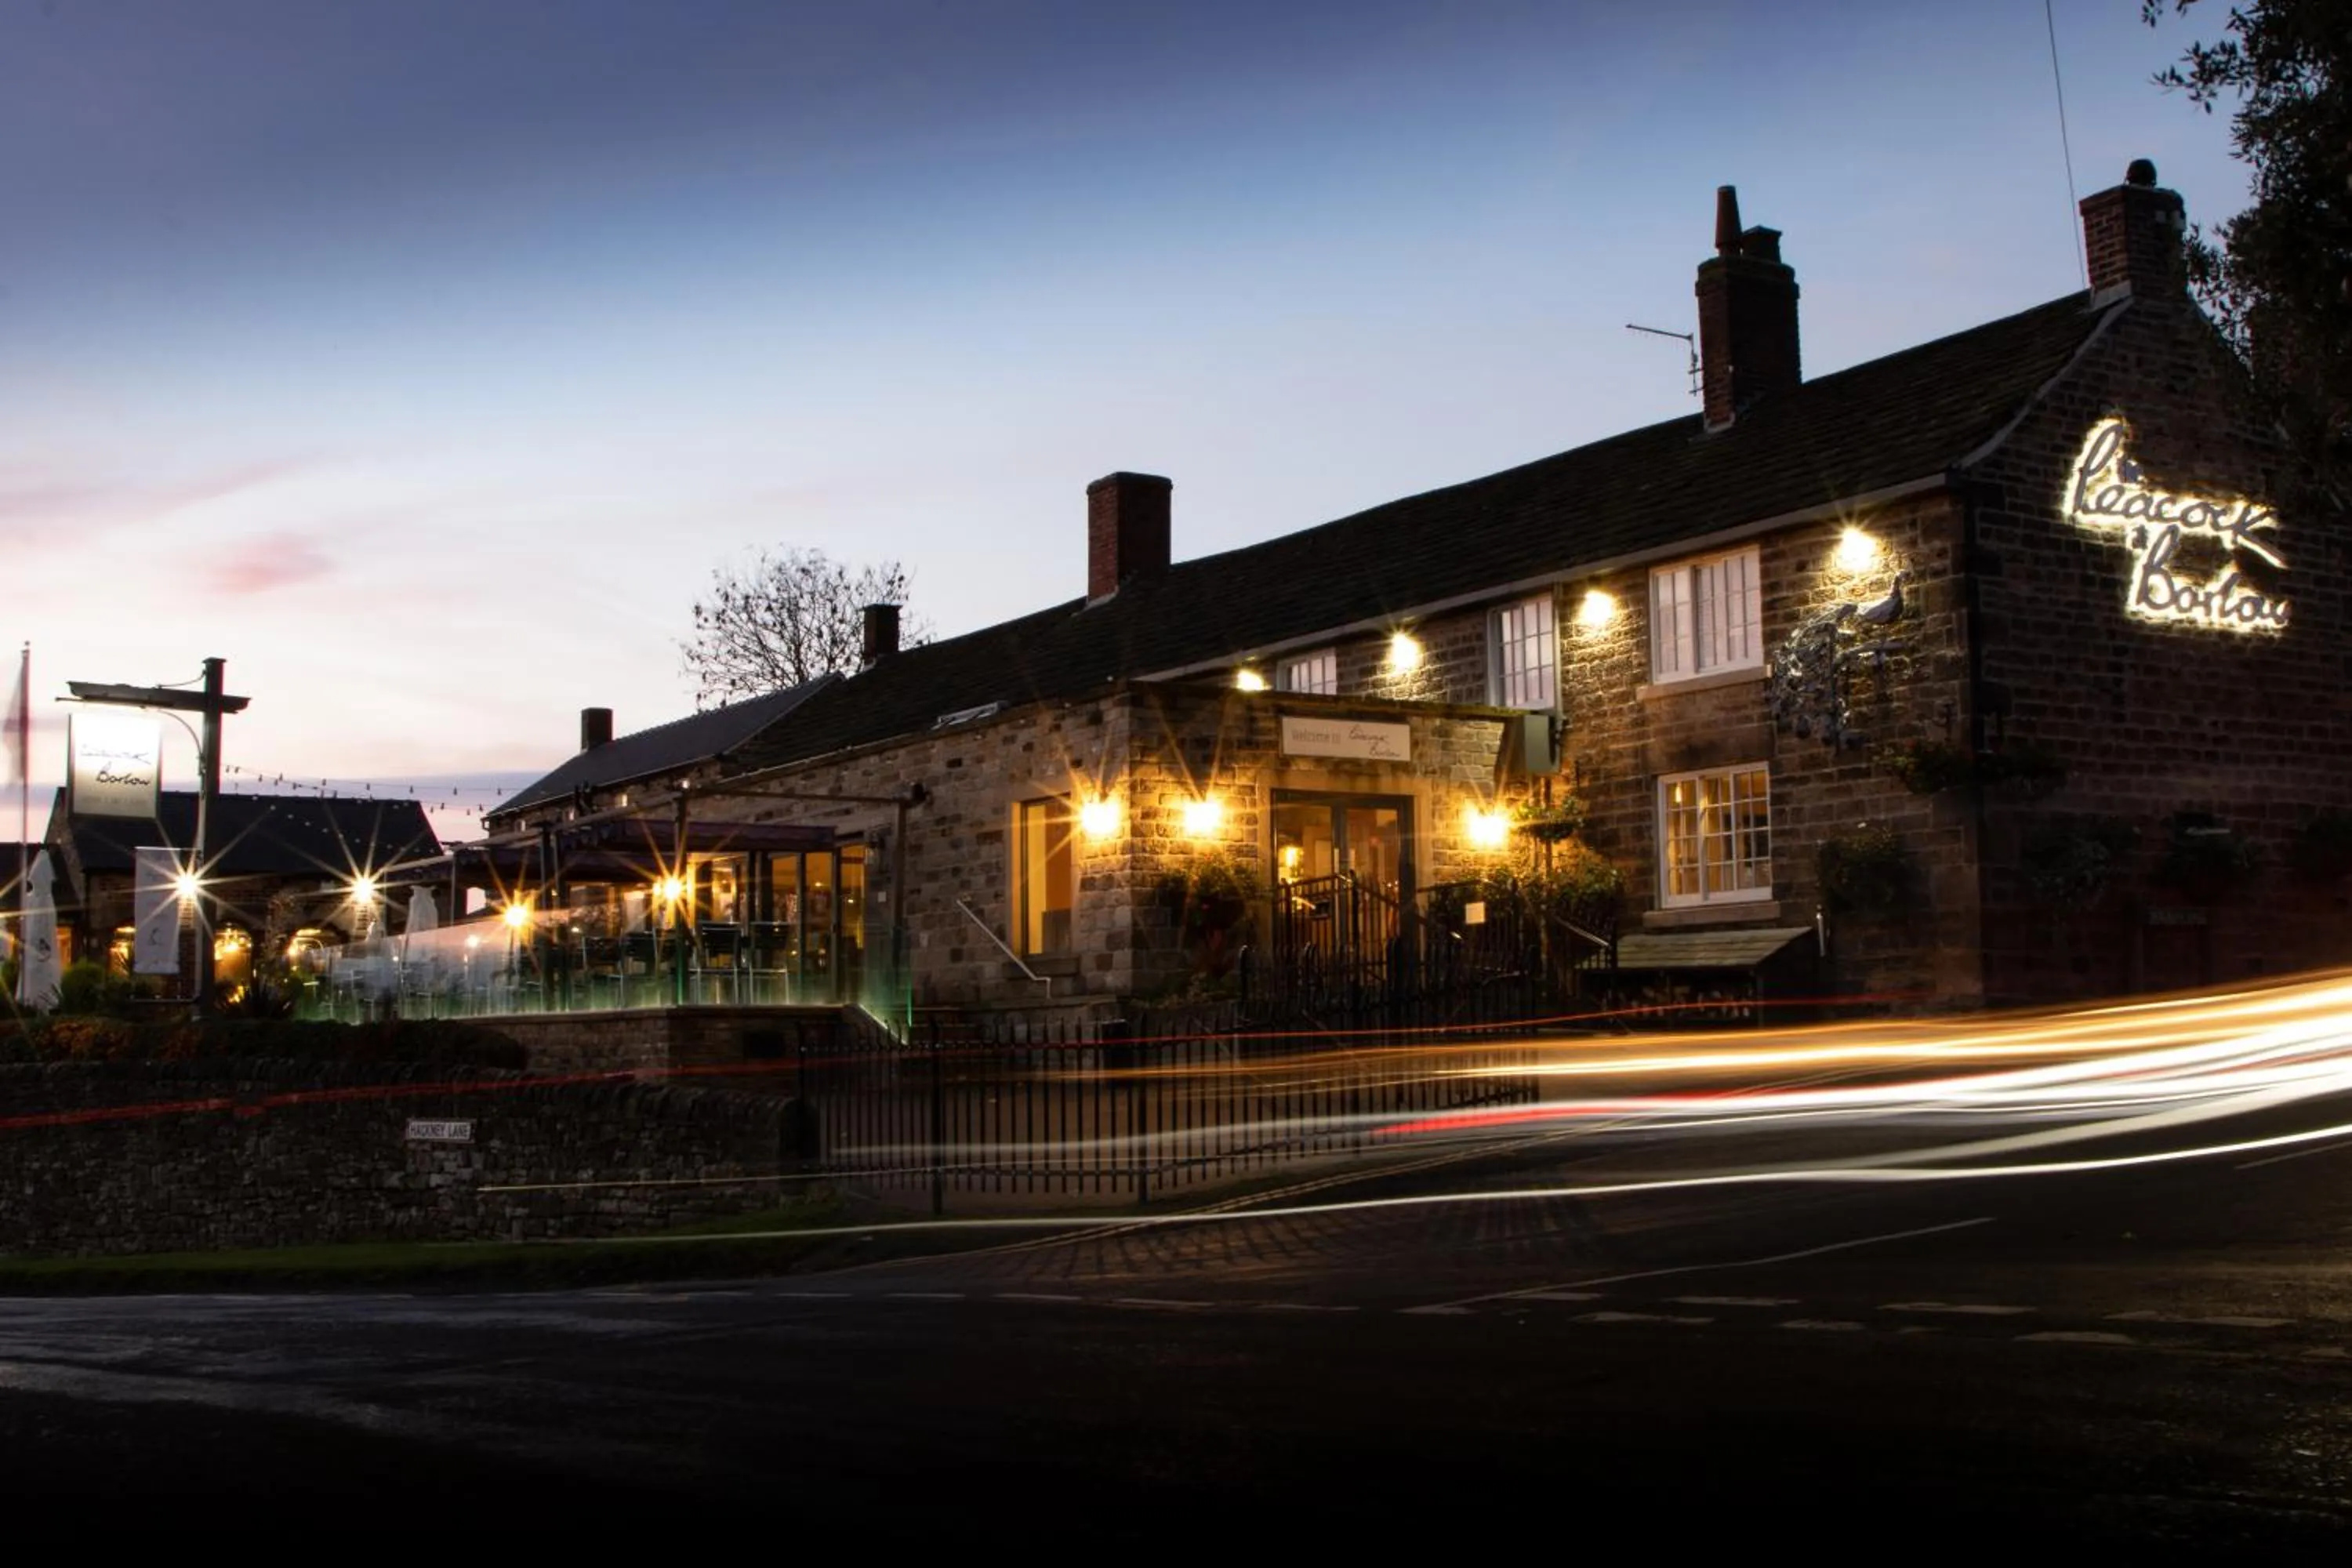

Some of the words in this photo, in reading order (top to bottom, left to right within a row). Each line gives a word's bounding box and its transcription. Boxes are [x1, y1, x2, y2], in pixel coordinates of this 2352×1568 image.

[2071, 420, 2288, 569] Peacock
[96, 760, 151, 786] Barlow
[448, 1124, 468, 1138] LANE
